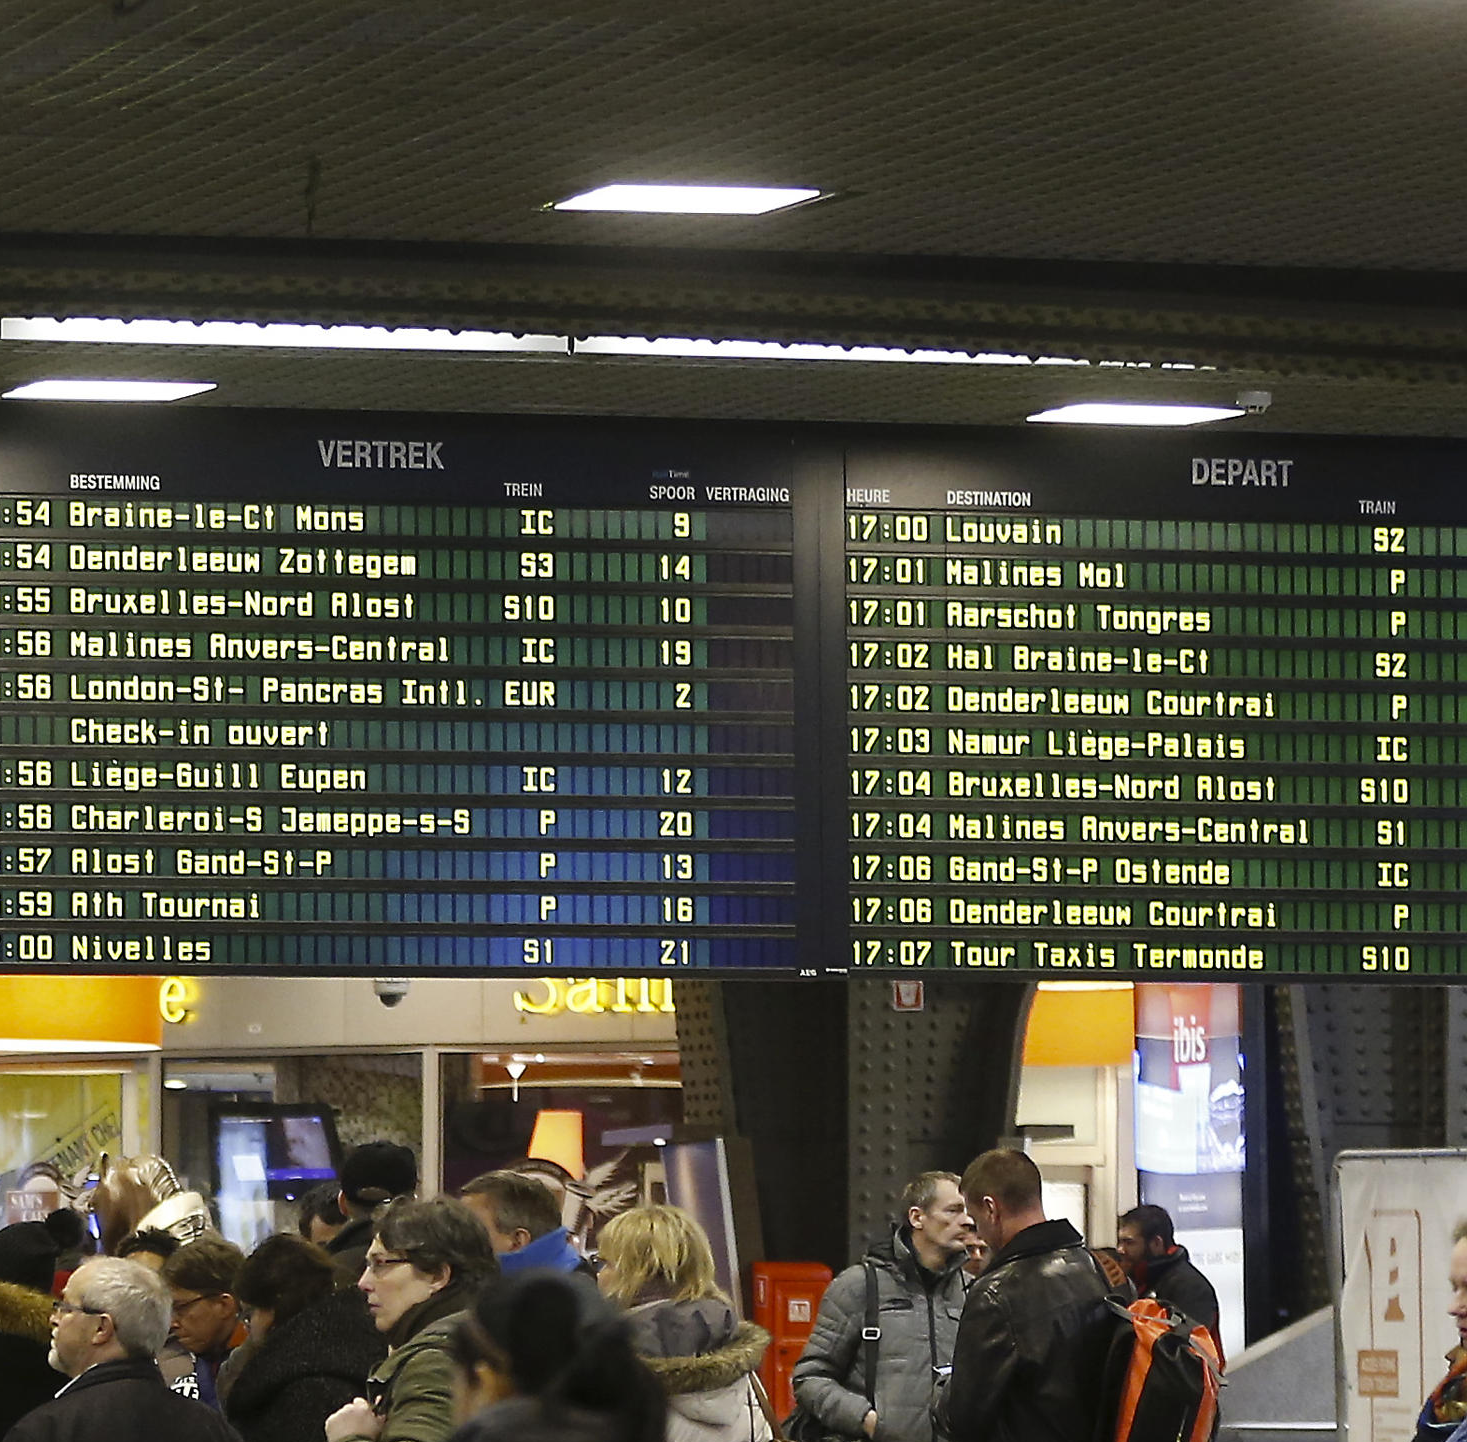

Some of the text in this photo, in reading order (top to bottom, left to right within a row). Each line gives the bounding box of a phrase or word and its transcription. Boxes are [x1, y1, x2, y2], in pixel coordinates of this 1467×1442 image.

[317, 439, 445, 470] VERTREK
[70, 474, 160, 491] BESTEMMING
[503, 482, 543, 497] TREIN
[649, 485, 696, 500] SPOOR
[705, 486, 790, 502] VERTRAGING
[1191, 458, 1293, 487] DEPART
[846, 487, 1396, 515] HEURE DESTINATION TRAIN
[69, 501, 274, 530] Braine-le-Ct
[296, 505, 364, 531] Mons
[521, 509, 553, 535] IC
[674, 512, 690, 537] 9
[848, 515, 1405, 553] 17:00 Louvain S2
[850, 642, 1407, 678] 17:02 Hal Braine-le-Ct S2
[263, 677, 383, 704] Pancras
[402, 679, 482, 706] Intl.
[505, 680, 555, 706] EUR
[676, 683, 691, 708] 2
[71, 718, 328, 746] Check-in ouvert
[851, 727, 1408, 762] 17:03 Namur Liège-Palais IC
[71, 805, 262, 834] Charleroi-S
[281, 807, 470, 837] Jemeppe-s-S
[540, 810, 556, 835] P
[660, 811, 692, 837] 20
[853, 940, 1409, 971] 17:07 Tour Taxis Termonde S10
[1172, 1014, 1207, 1064] ibis
